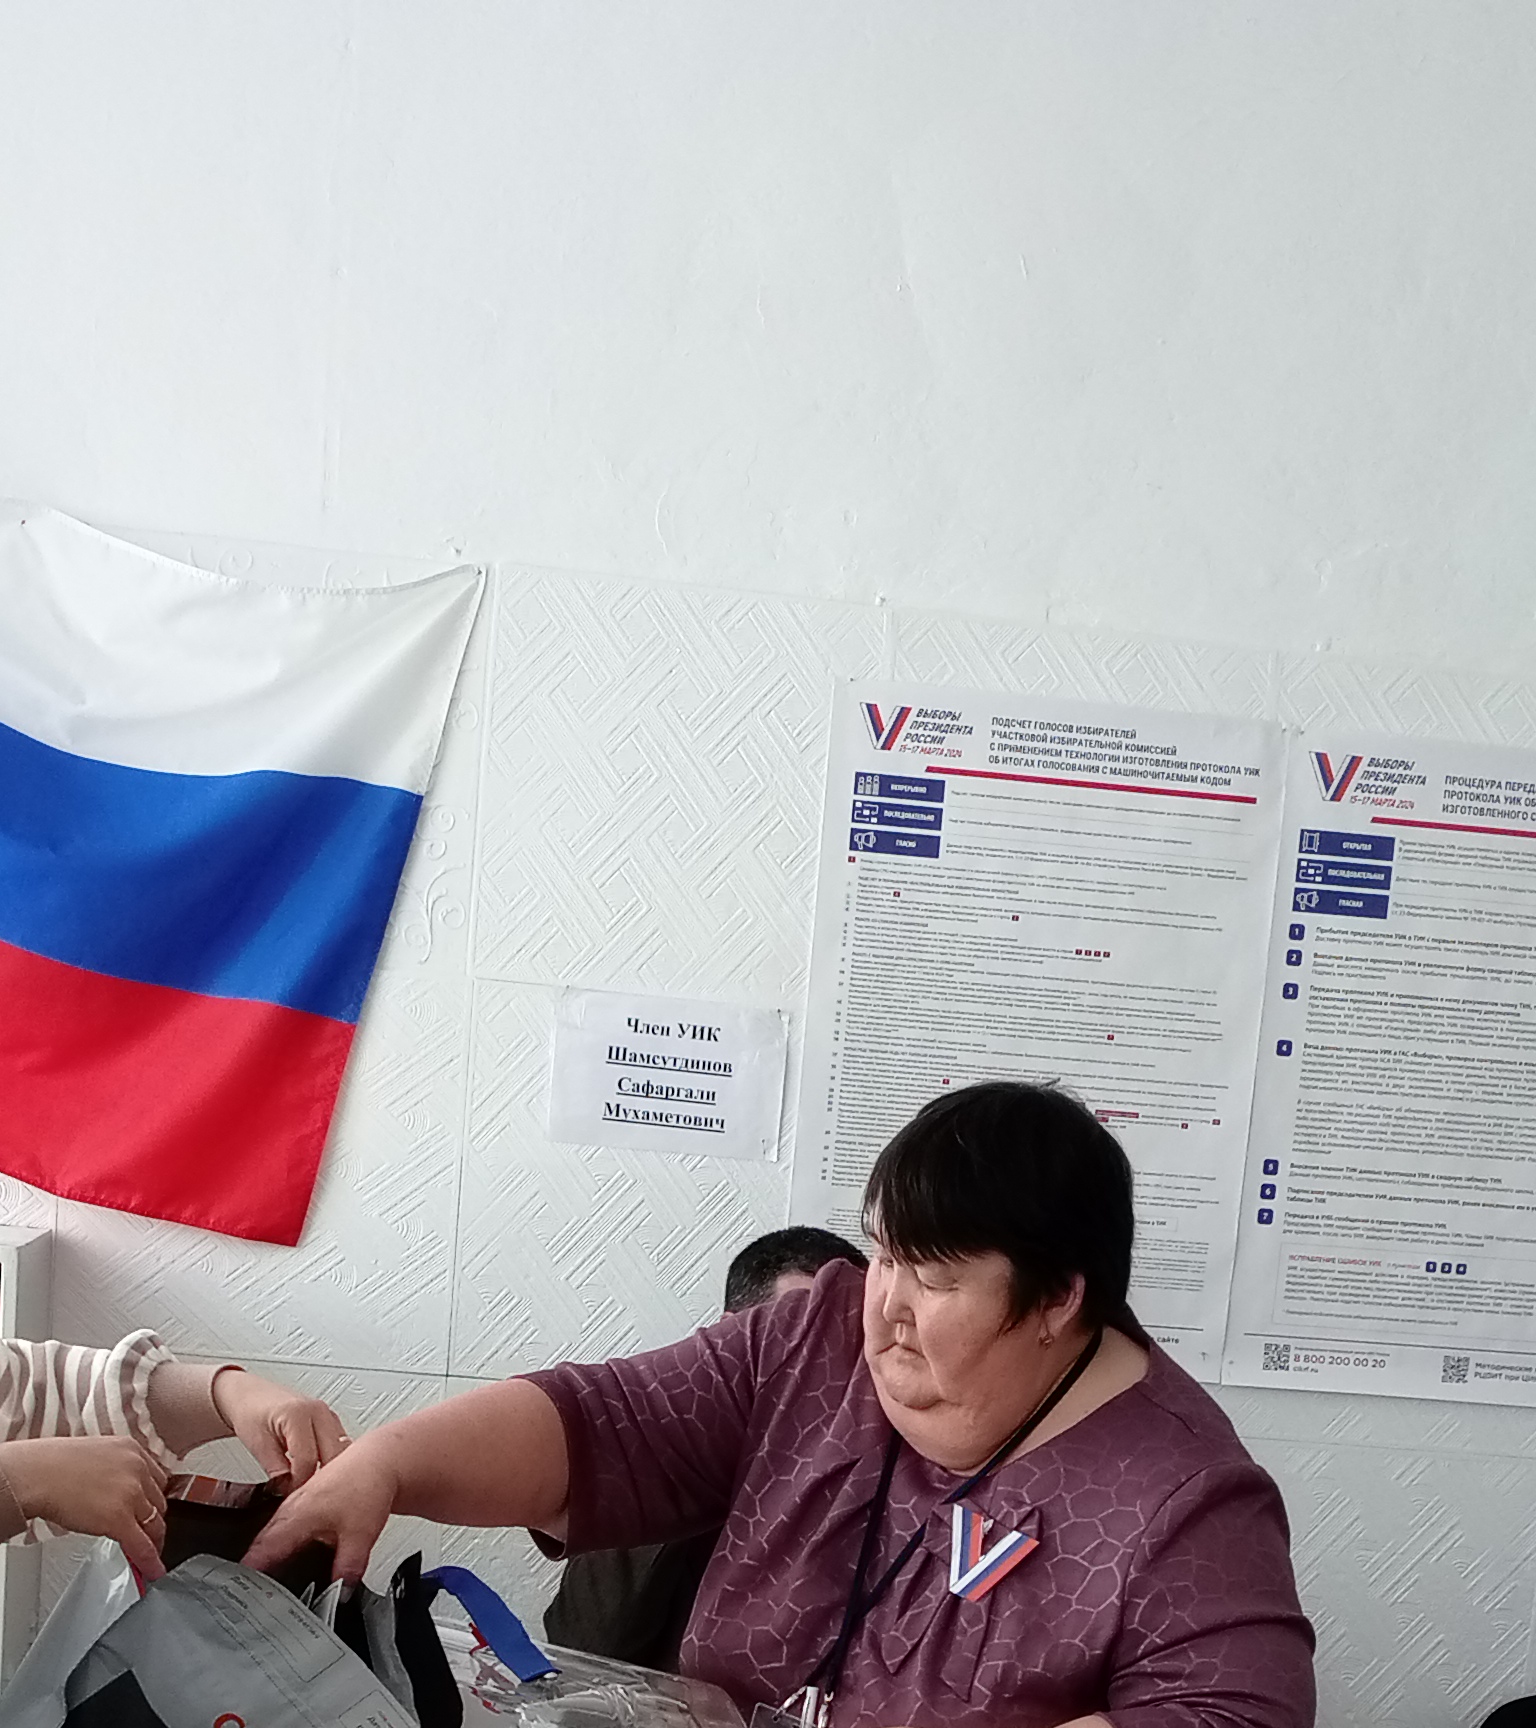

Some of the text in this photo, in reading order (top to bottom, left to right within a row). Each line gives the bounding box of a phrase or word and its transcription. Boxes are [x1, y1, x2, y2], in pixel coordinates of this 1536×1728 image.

[916, 708, 962, 721] ВЫБОРЫ
[909, 720, 973, 735] ПРЕЗИДЕНТА
[991, 716, 1137, 740] ПОДСЧЕТ ГОЛОСОВ ИЗБИРАТЕЛЕЙ
[903, 732, 946, 745] РОССИИ
[990, 730, 1178, 757] УЧАСТКОВОЙ ИЗБИРАТЕЛЬНОЙ КОМИССИЕЙ
[997, 743, 1063, 758] ПРИМЕНЕНИЕМ
[1065, 749, 1121, 764] ТЕХНОЛОГИИ
[1122, 755, 1188, 770] ИЗГОТОВЛЕНИЯ
[1190, 761, 1242, 775] ПРОТОКОЛА
[1367, 757, 1415, 771] ВЫБОРЫ
[988, 755, 1001, 764] ОБ
[1002, 756, 1035, 769] ИТОГАХ
[1036, 759, 1100, 775] ГОЛОСОВАНИЯ
[1109, 767, 1198, 784] МАШИНОЧИТАЕМЫМ
[1199, 775, 1232, 787] КОДОМ
[1360, 769, 1427, 786] ПРЕЗИДЕНТА
[1354, 782, 1397, 796] РОССИИ
[1444, 775, 1503, 791] ПРОЦЕДУРА
[1443, 789, 1502, 805] ПРОТОКОЛА
[1503, 796, 1522, 807] УИК
[1524, 797, 1536, 807] ОБ
[1441, 803, 1529, 822] ИЗГОТОВЛЕННОГО
[627, 1017, 721, 1043] Член УИК
[606, 1045, 733, 1076] Шамсутдинов
[616, 1076, 717, 1103] Сафаргали
[602, 1101, 726, 1131] Мухаметович
[1303, 1354, 1325, 1364] 800
[1328, 1356, 1350, 1366] 200
[1353, 1357, 1369, 1367] 00
[1371, 1359, 1386, 1369] 20
